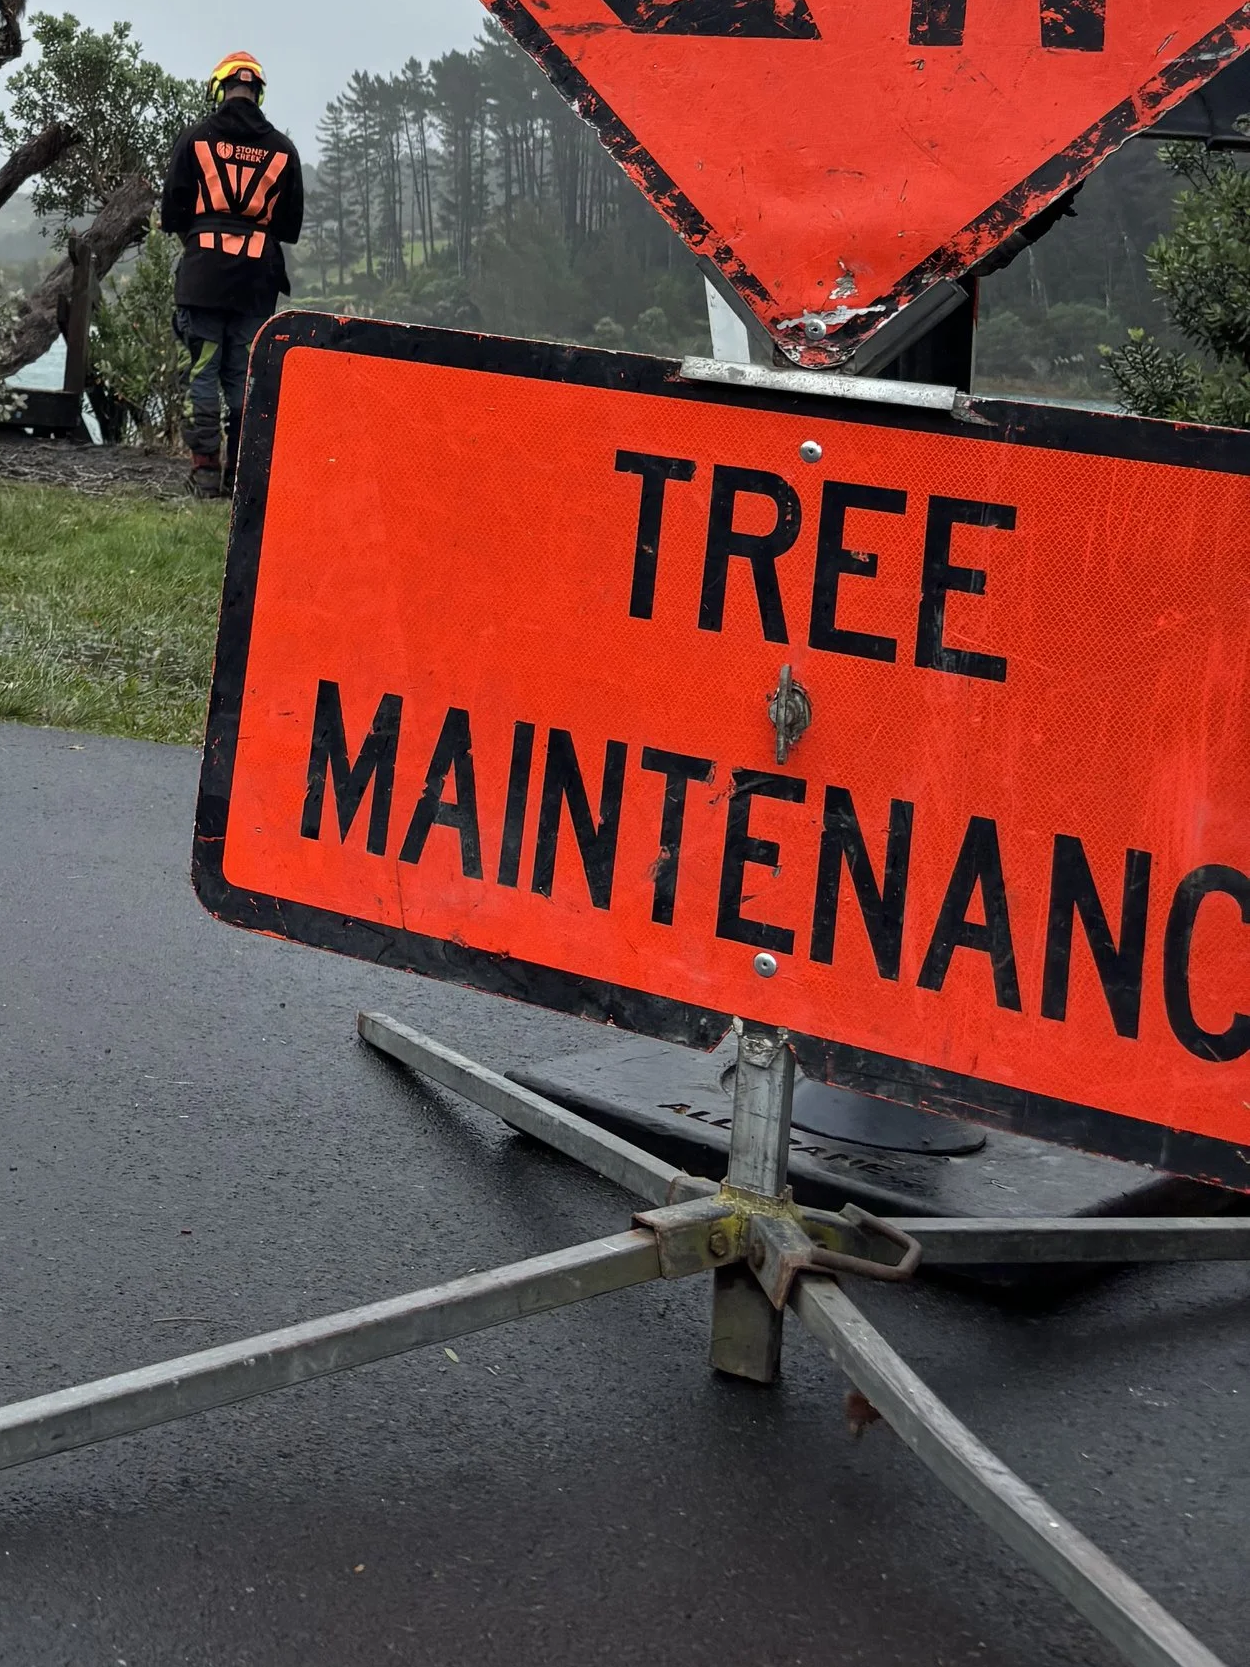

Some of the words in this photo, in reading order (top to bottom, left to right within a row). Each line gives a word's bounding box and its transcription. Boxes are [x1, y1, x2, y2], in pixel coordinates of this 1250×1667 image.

[235, 145, 269, 158] STONEY
[614, 449, 1018, 683] TREE
[300, 678, 1250, 1063] MAINTENANC
